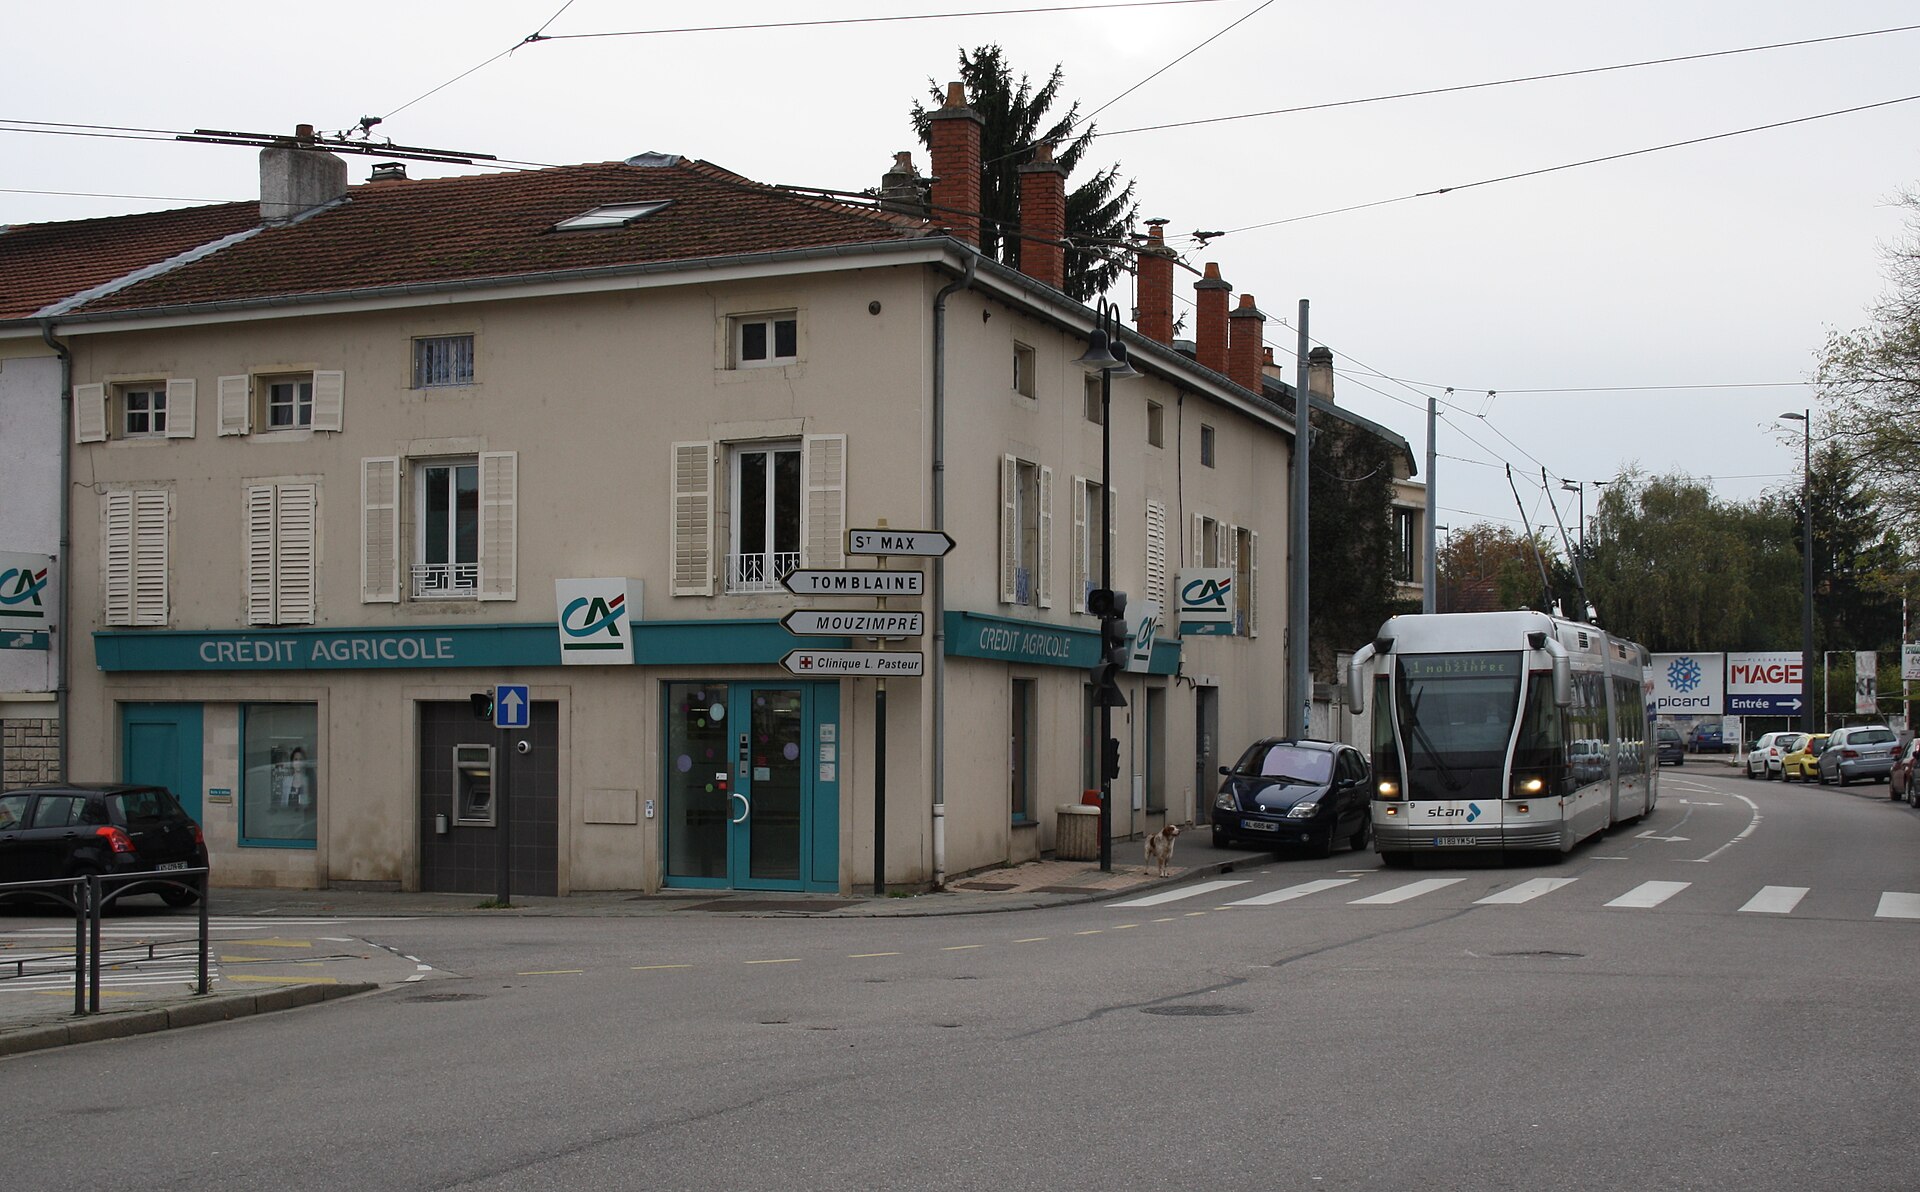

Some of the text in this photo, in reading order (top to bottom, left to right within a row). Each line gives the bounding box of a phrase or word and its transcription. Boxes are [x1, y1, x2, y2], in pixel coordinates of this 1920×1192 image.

[881, 536, 914, 550] MAX
[811, 576, 917, 590] TOMBLAINE
[816, 614, 918, 630] MOUZIMPRÉ
[980, 624, 1070, 658] CRÉDIT AGRICOLE
[200, 636, 454, 662] CRÉDIT AGRICOLE
[818, 658, 919, 670] Clinique L. Pasteur
[1731, 664, 1803, 684] MAGE
[1658, 696, 1710, 709] picard
[1732, 698, 1769, 708] Entrée
[1428, 806, 1464, 817] stan
